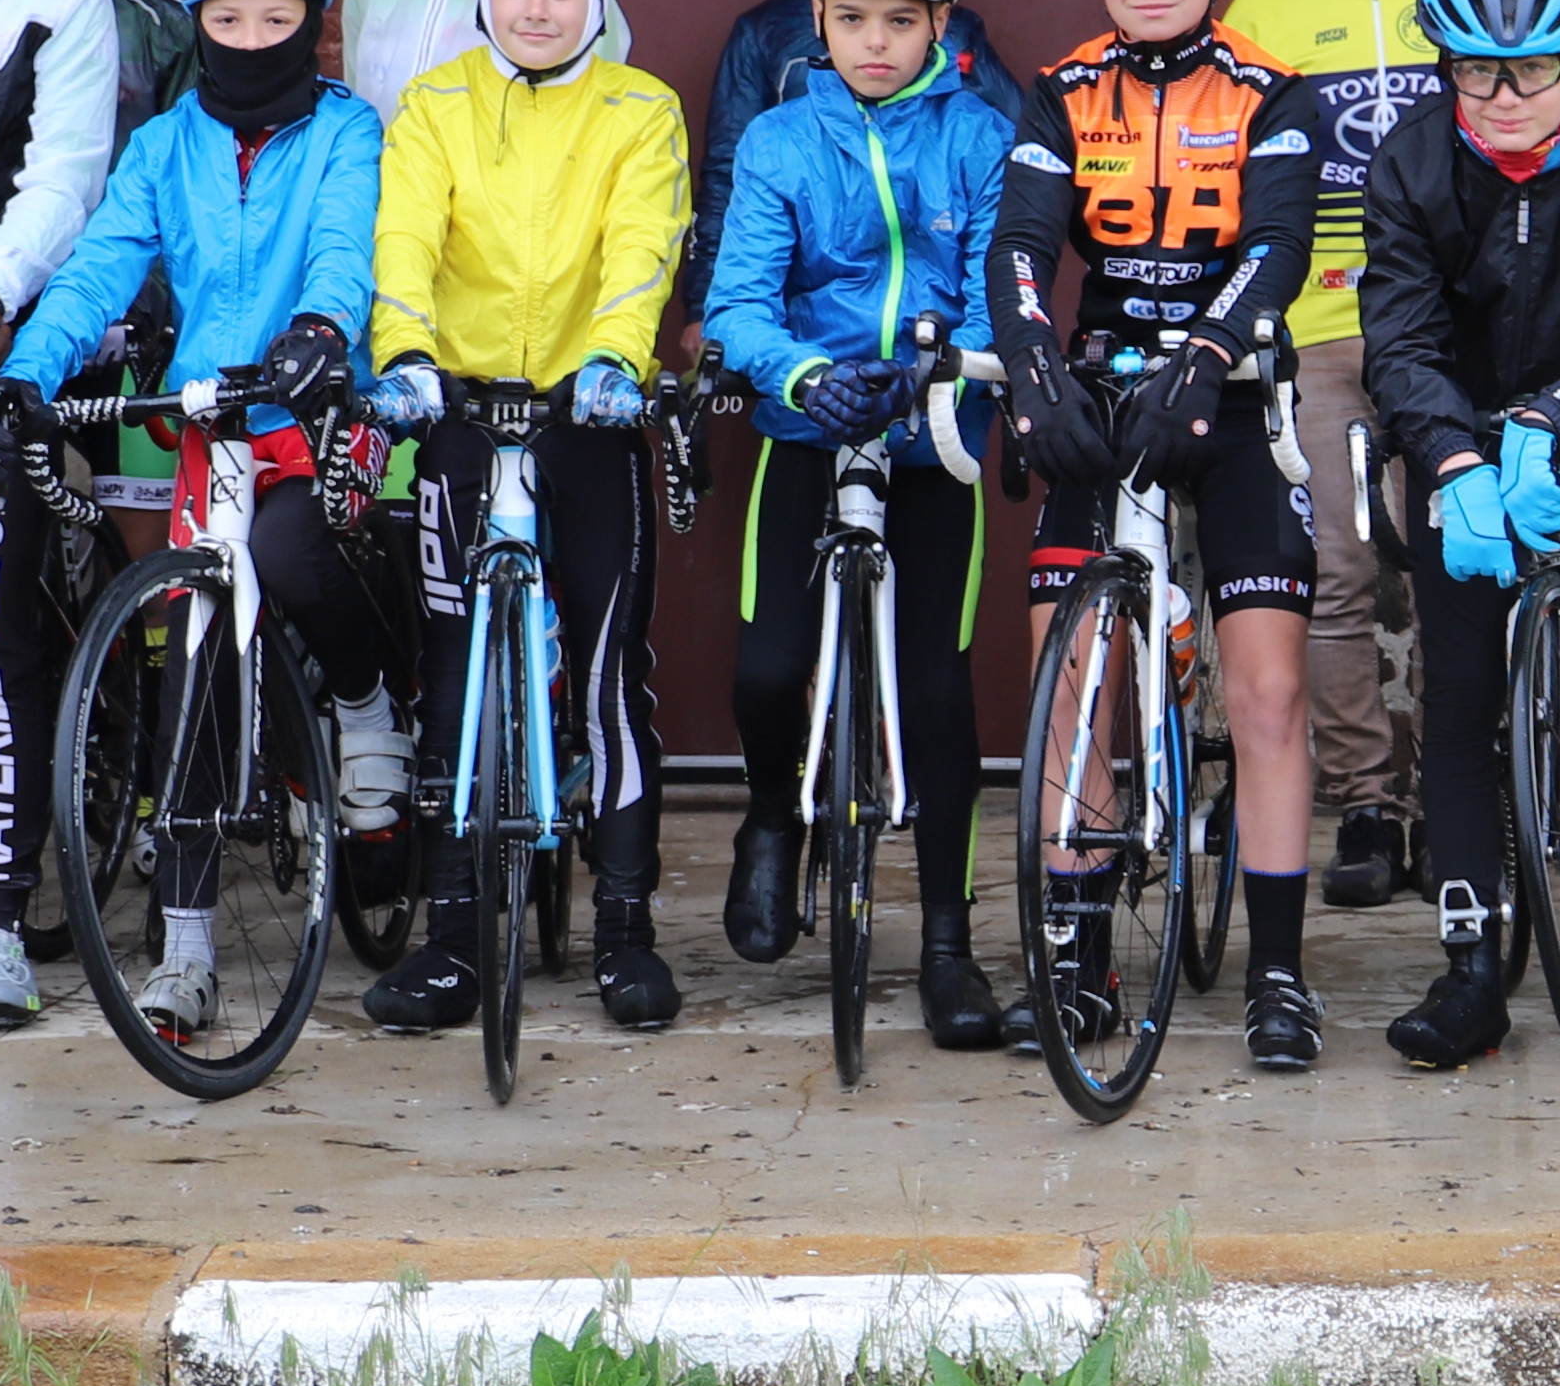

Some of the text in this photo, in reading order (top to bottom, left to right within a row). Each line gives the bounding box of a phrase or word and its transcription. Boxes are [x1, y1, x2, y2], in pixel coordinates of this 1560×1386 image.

[1320, 72, 1442, 105] TOYOTA
[628, 451, 642, 545] PERFORMANCE
[418, 478, 466, 618] poli
[629, 547, 641, 573] FOR
[1220, 576, 1309, 600] EVASION
